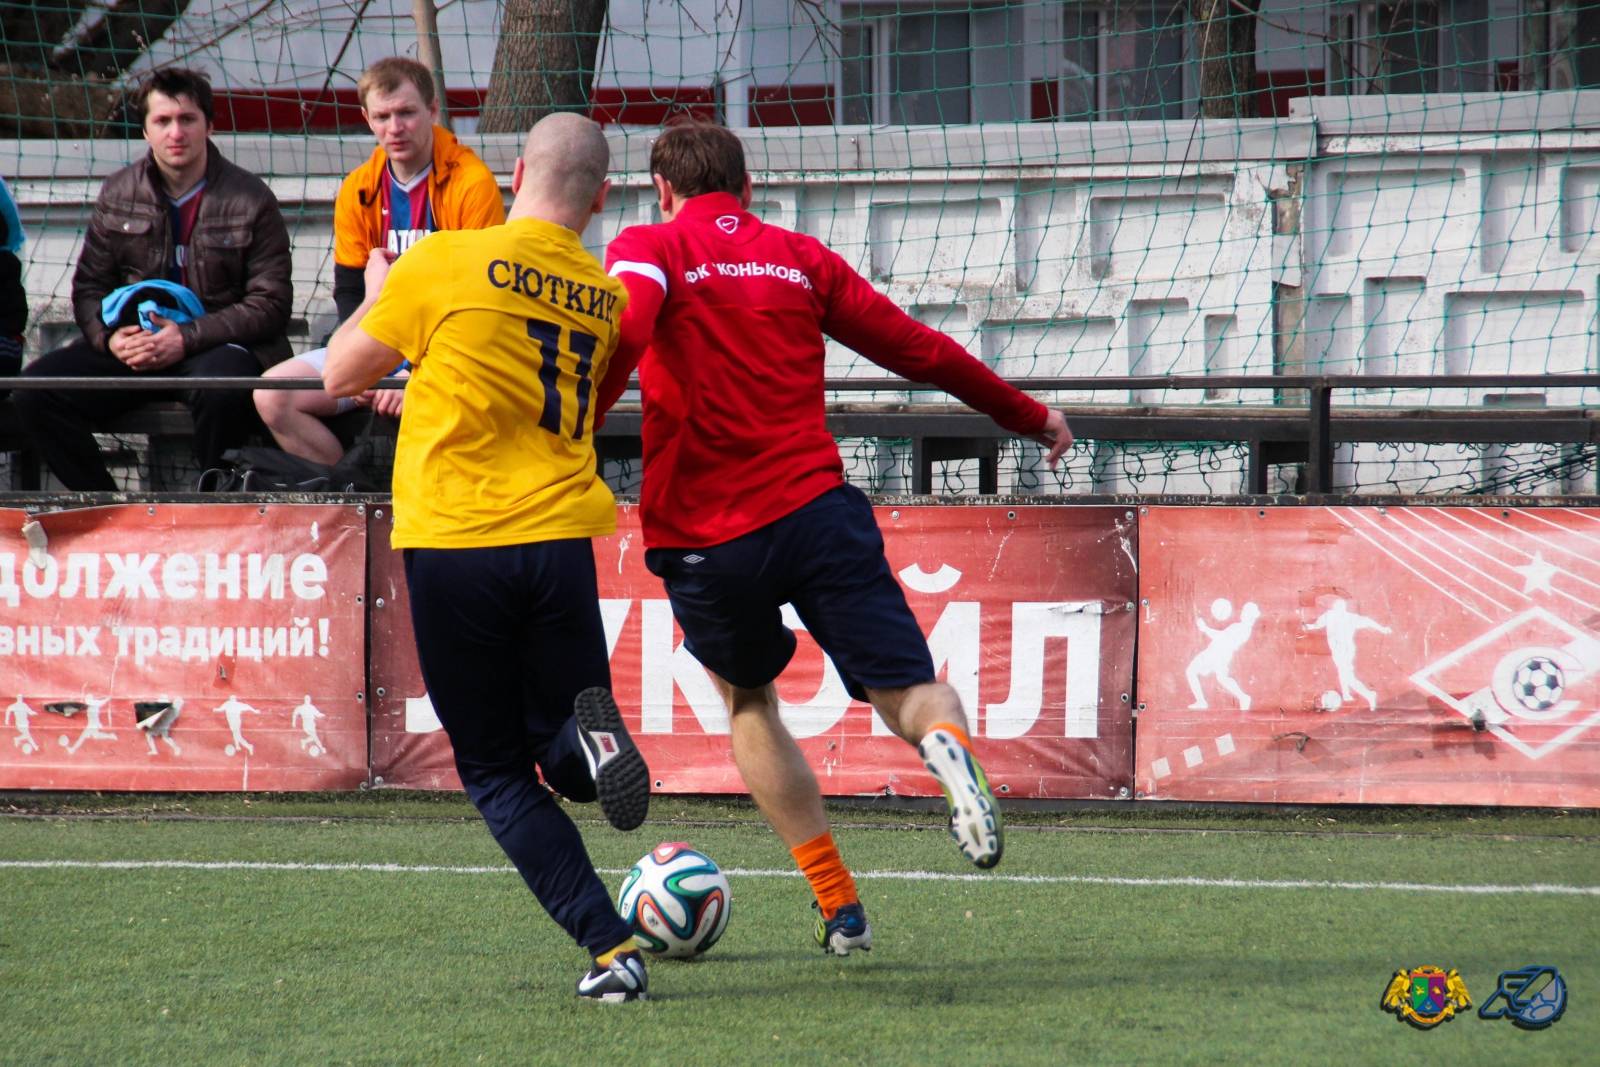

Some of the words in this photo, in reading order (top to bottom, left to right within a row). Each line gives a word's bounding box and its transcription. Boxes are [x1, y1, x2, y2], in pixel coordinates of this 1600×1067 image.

[487, 259, 618, 325] СЮТКИН
[685, 263, 711, 283] ФК
[526, 318, 598, 441] 11
[111, 616, 330, 666] традиций!
